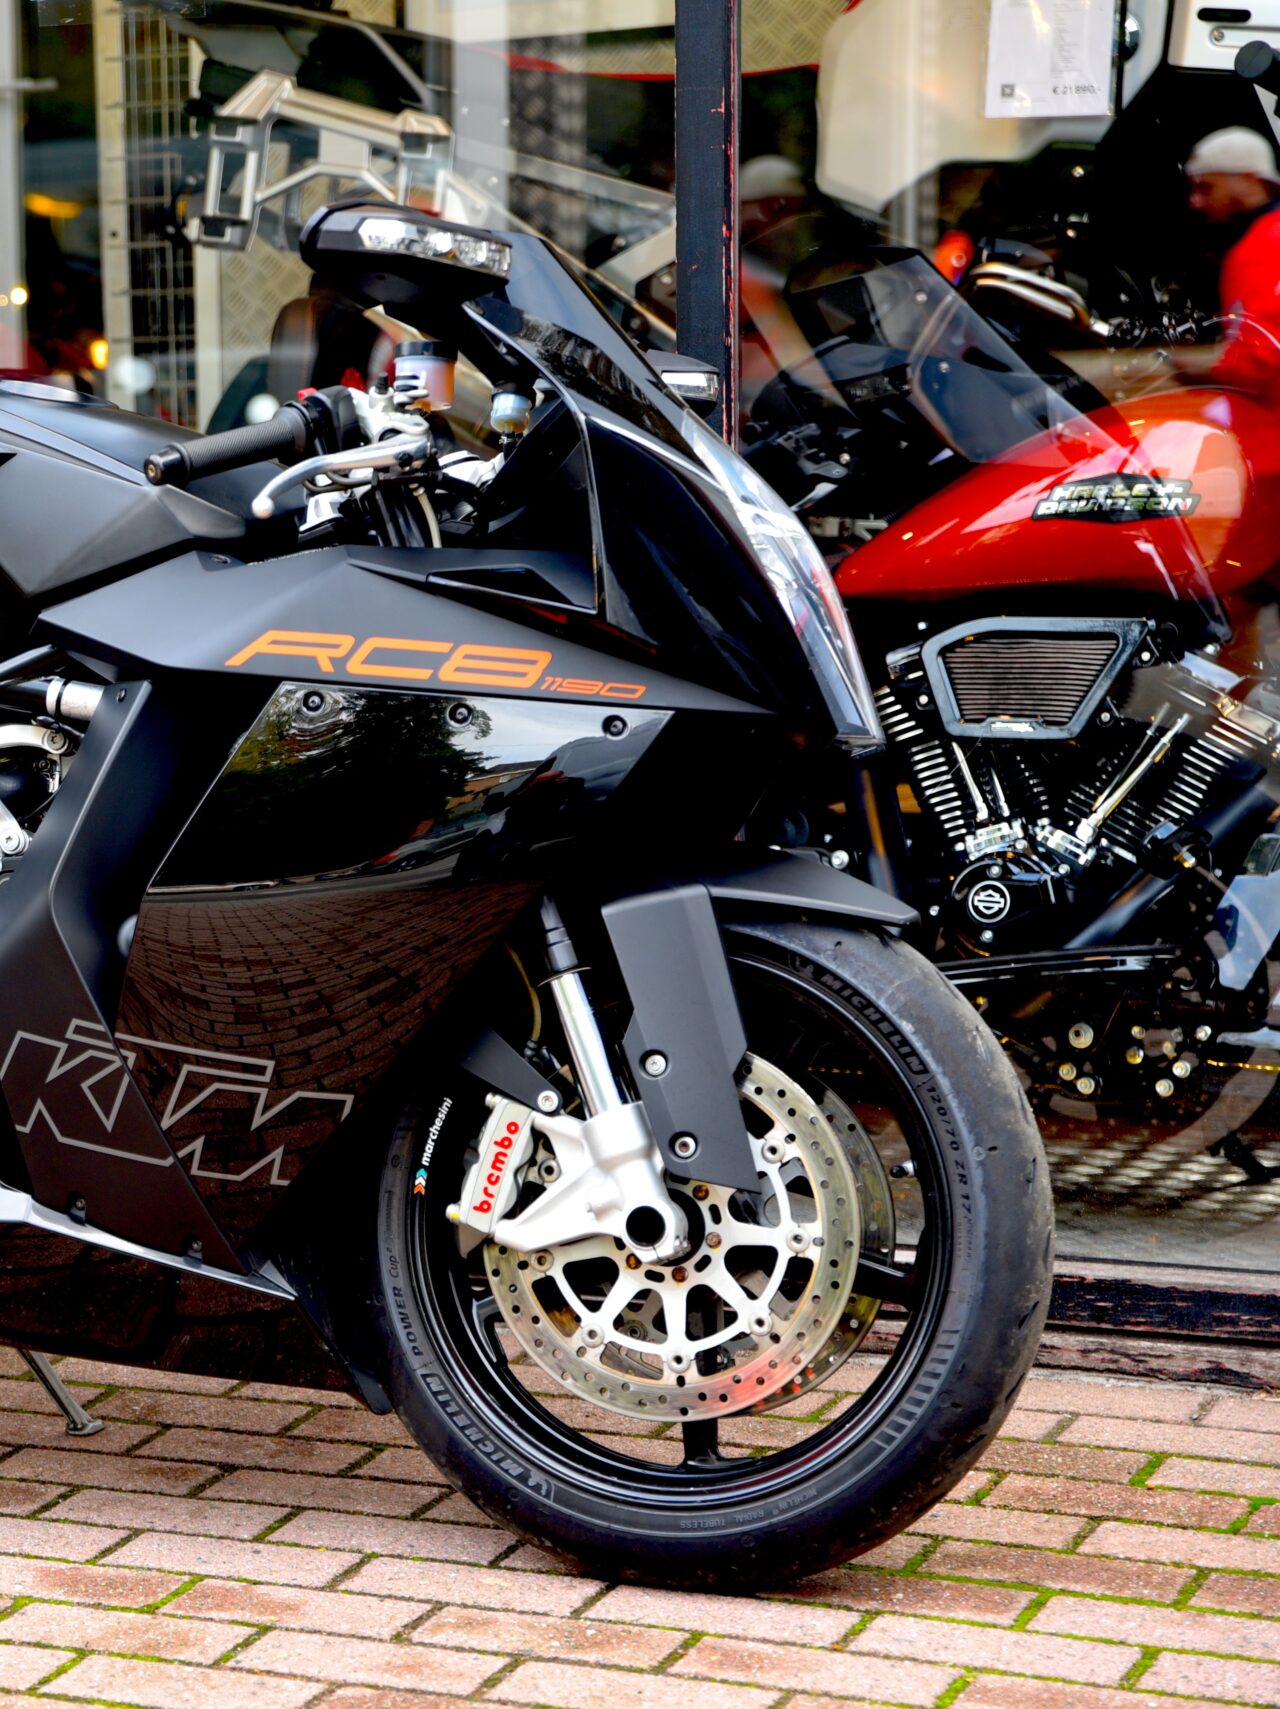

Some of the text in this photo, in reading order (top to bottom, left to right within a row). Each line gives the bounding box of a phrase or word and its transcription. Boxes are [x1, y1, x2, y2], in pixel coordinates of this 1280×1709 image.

[223, 629, 647, 700] RC8 1190
[821, 973, 925, 1072] MICHELIN
[0, 1018, 355, 1187] KTM
[420, 1097, 453, 1167] marchesini
[926, 1085, 960, 1152] 120/70
[954, 1159, 968, 1186] ZR
[472, 1121, 520, 1214] brembo
[388, 1255, 400, 1279] Cup
[392, 1286, 424, 1357] POWER
[425, 1376, 524, 1477] MICHELIN
